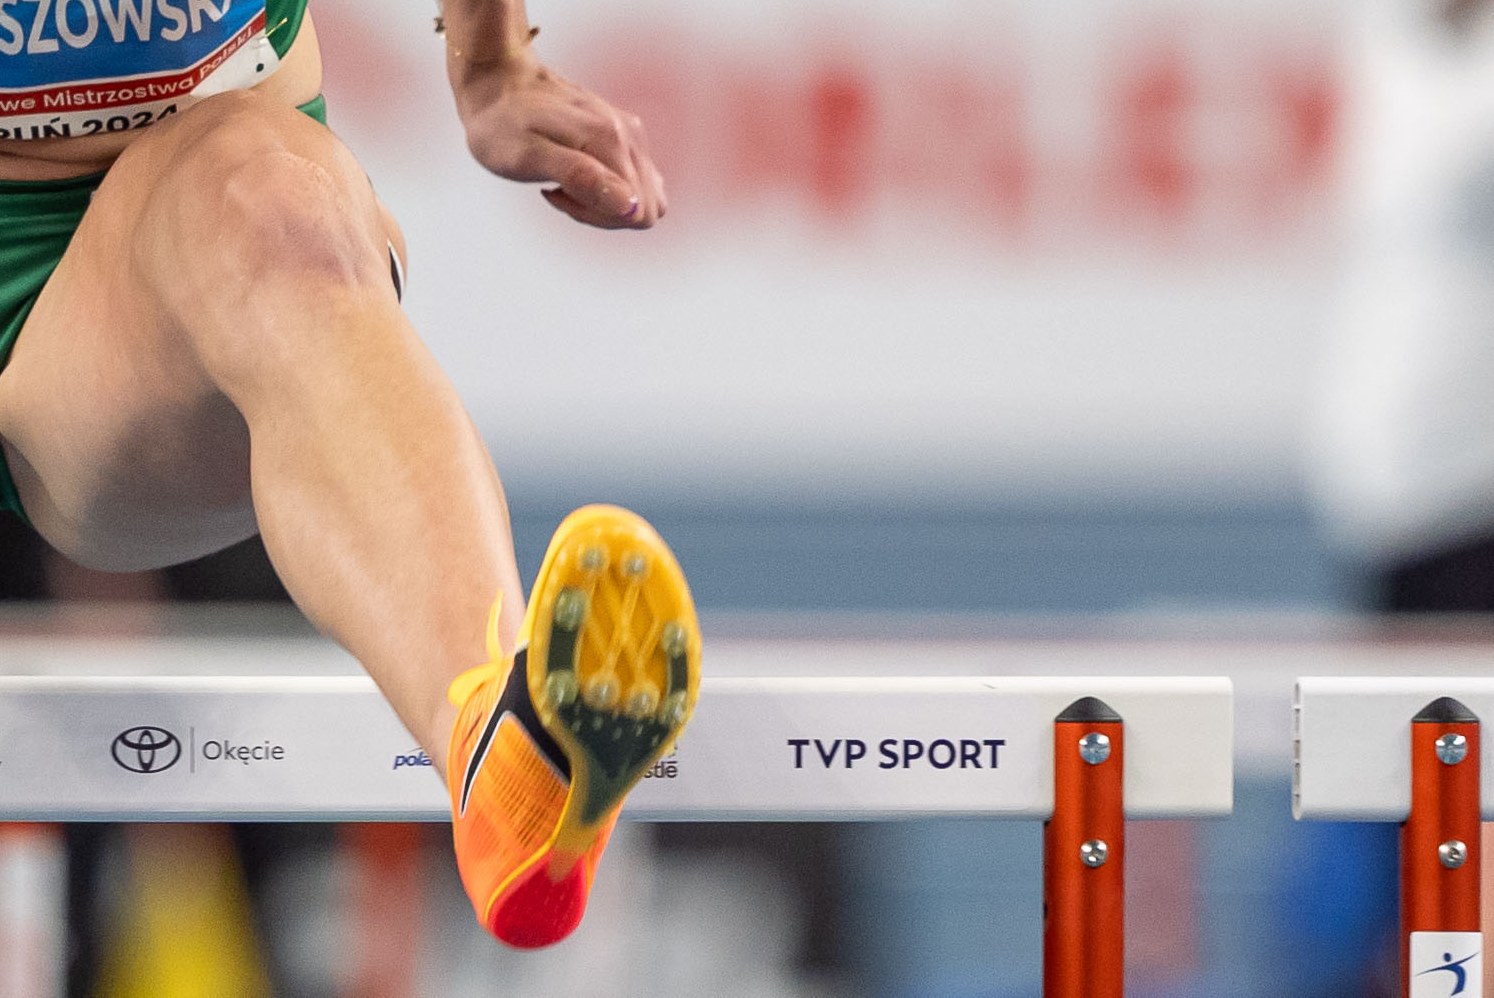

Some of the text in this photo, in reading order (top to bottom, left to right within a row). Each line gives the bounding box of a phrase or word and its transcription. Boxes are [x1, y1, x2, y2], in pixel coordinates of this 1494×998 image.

[42, 78, 195, 107] Mistrzostwa
[202, 739, 285, 766] Okęcie
[787, 738, 1006, 770] TVP SPORT
